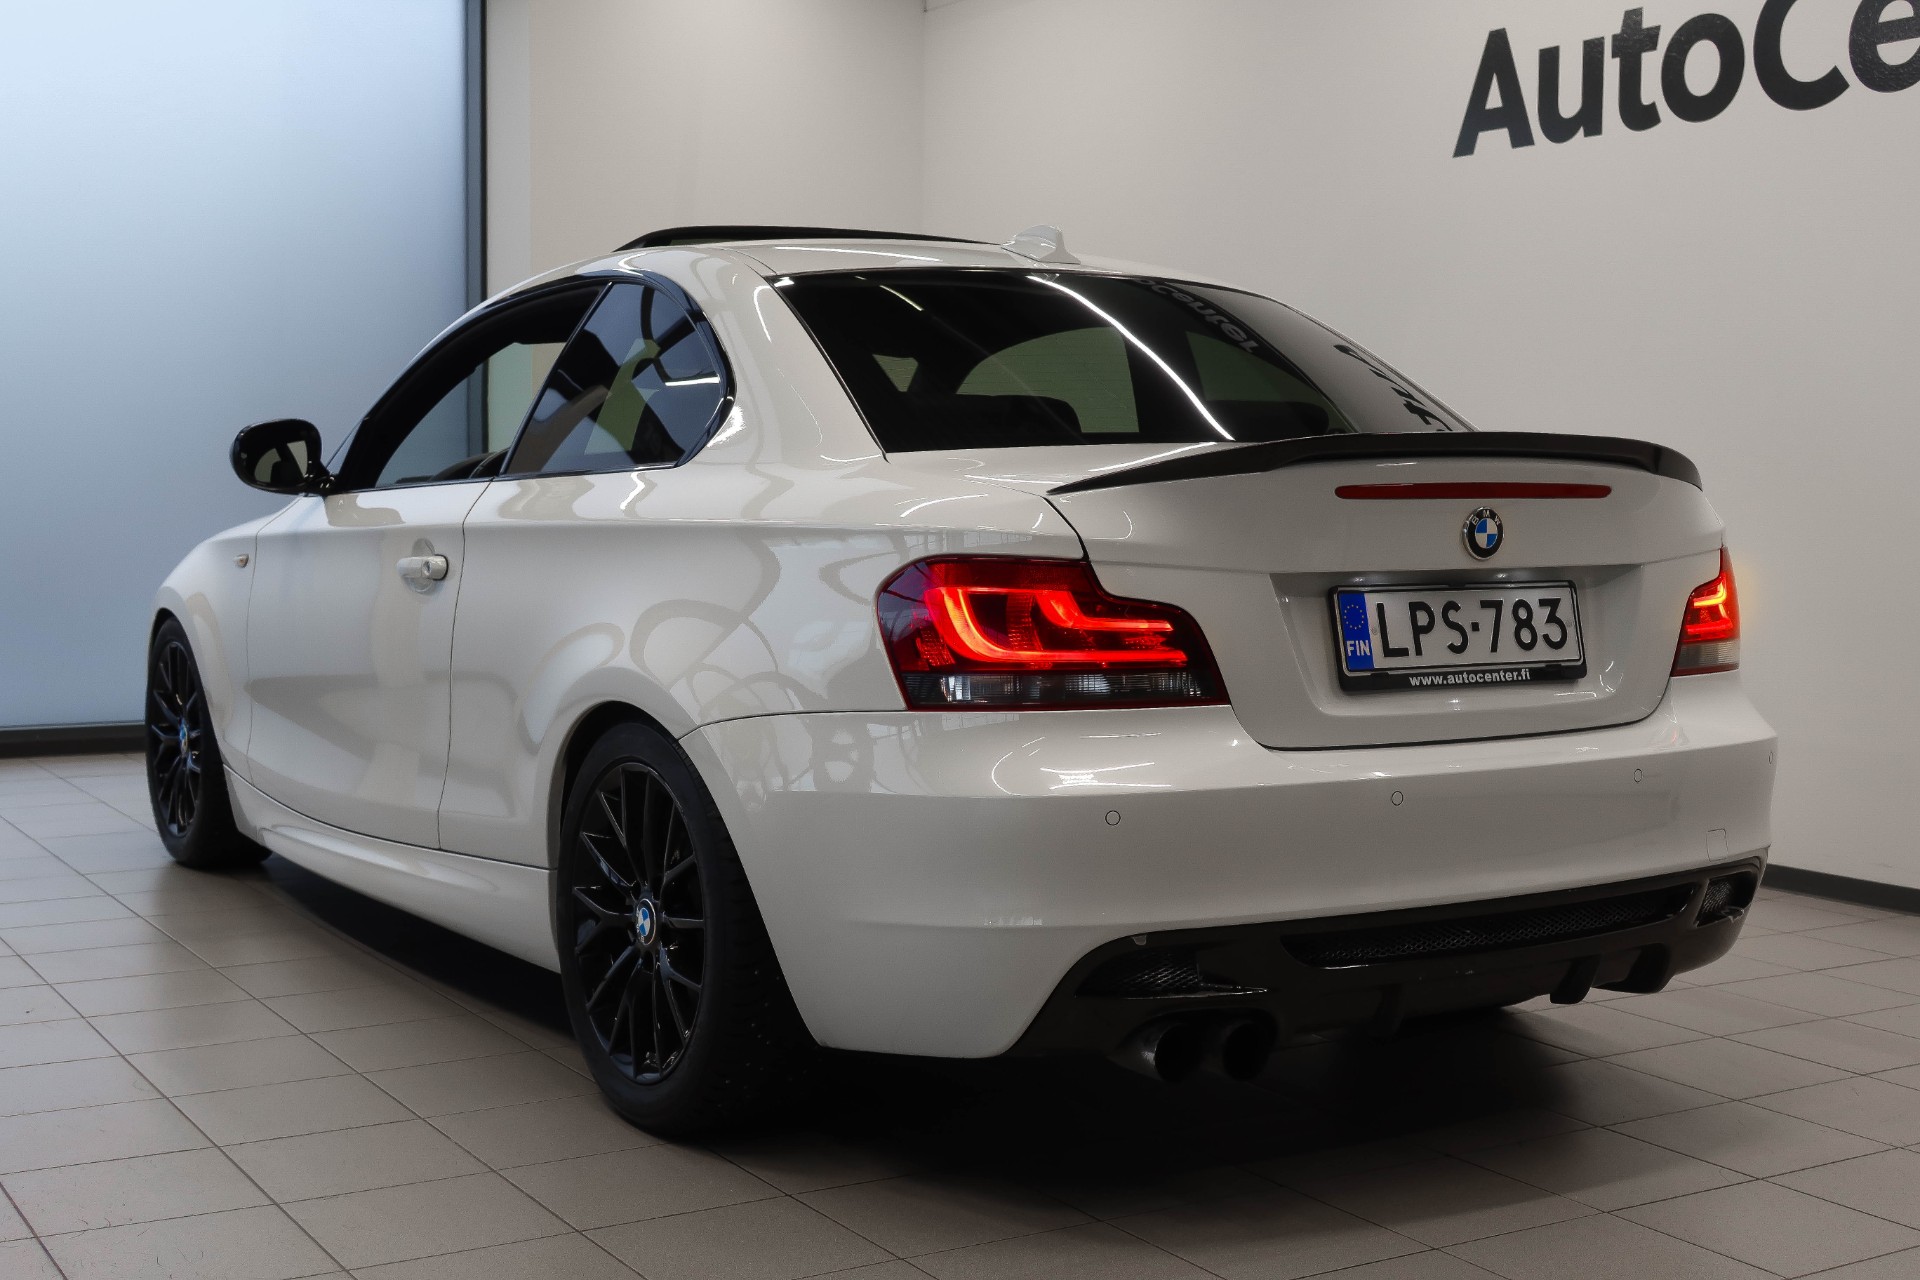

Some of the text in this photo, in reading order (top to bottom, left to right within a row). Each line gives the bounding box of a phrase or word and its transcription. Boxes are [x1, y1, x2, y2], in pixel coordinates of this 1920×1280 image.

[1471, 509, 1501, 526] BMW
[1376, 597, 1568, 658] LPS-783
[1346, 639, 1372, 657] FIN
[1408, 668, 1531, 687] www.autocenter.fi
